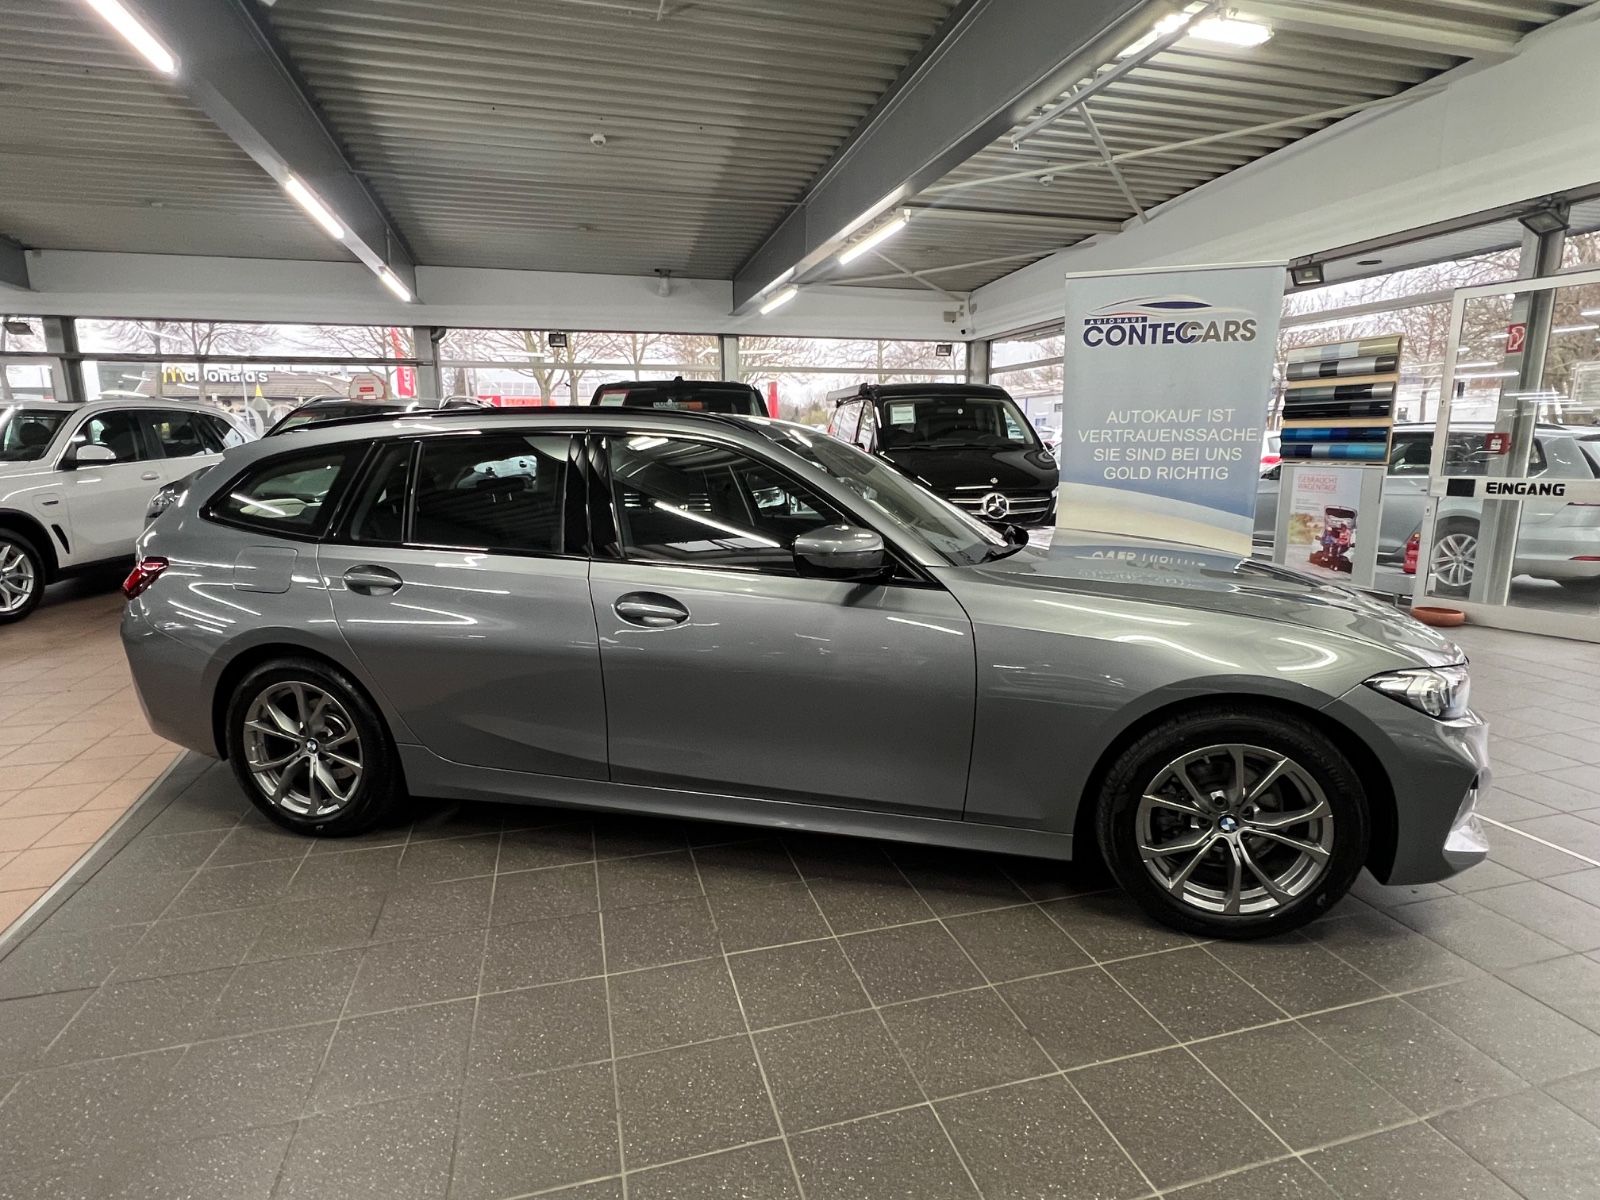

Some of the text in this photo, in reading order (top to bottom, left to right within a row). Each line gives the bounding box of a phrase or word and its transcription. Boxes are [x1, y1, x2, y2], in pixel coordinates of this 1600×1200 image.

[1089, 316, 1144, 326] AUTOHAUS
[1106, 408, 1236, 424] AUTOKAUF IST
[1093, 447, 1243, 462] SIE SIND BEI UNS
[1103, 466, 1229, 480] GOLD RICHTIG
[1485, 482, 1566, 496] EINGANG
